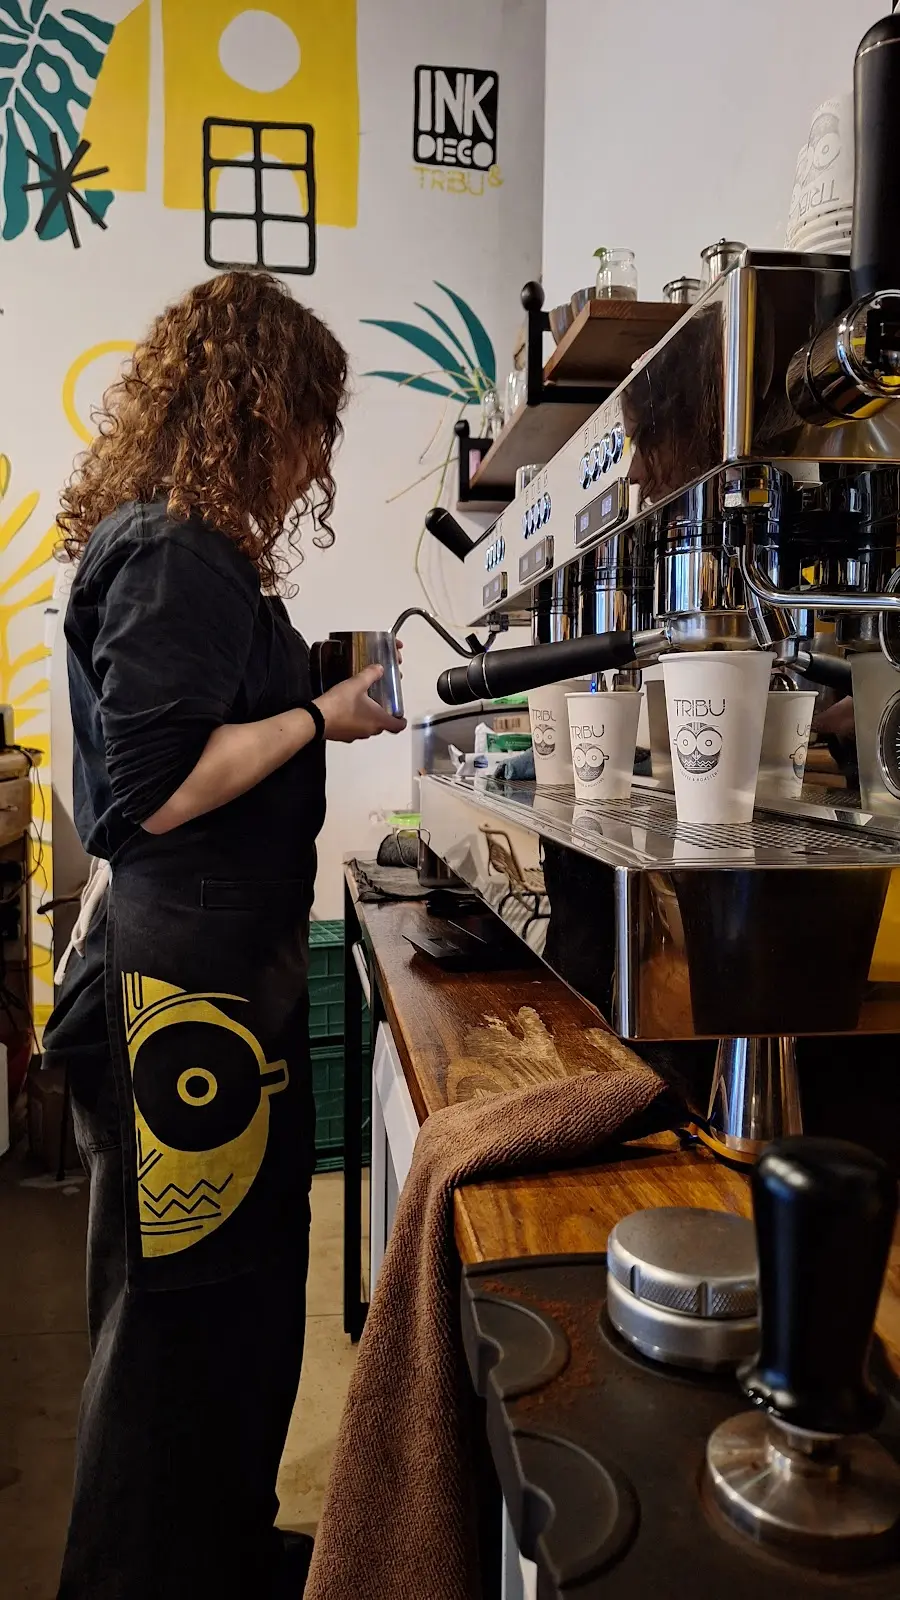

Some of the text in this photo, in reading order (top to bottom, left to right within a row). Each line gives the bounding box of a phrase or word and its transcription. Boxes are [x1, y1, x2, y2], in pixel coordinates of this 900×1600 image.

[418, 69, 495, 140] INK
[417, 133, 494, 168] DIEGO
[797, 179, 840, 221] TRIB
[673, 698, 726, 717] TRIBU
[570, 724, 605, 739] TRIBU
